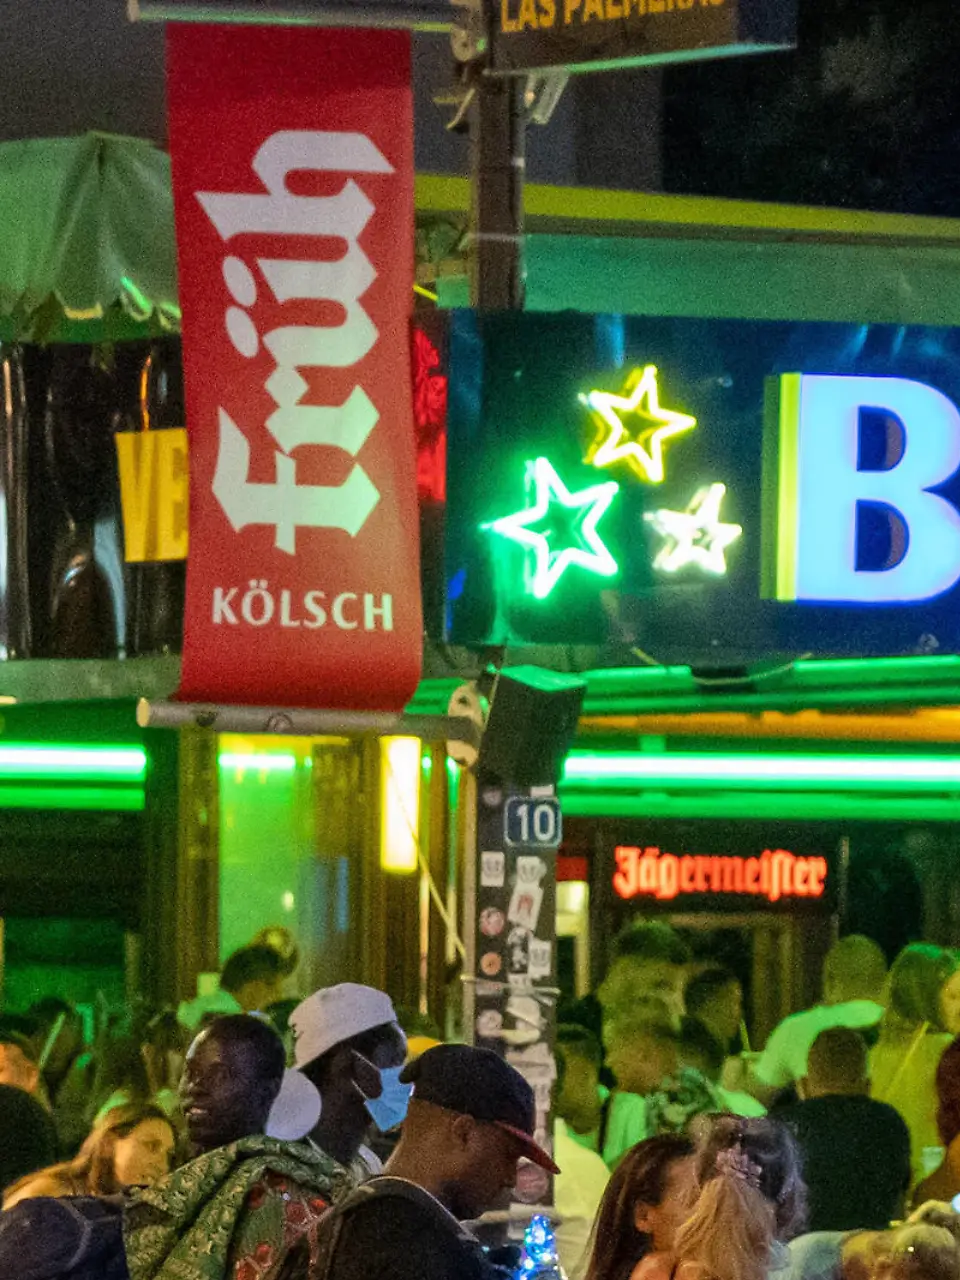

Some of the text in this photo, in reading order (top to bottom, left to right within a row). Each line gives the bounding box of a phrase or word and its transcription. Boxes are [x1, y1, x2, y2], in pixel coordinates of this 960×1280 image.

[501, 0, 556, 33] LAS
[212, 578, 394, 632] KÖLSCH
[515, 803, 556, 842] 10
